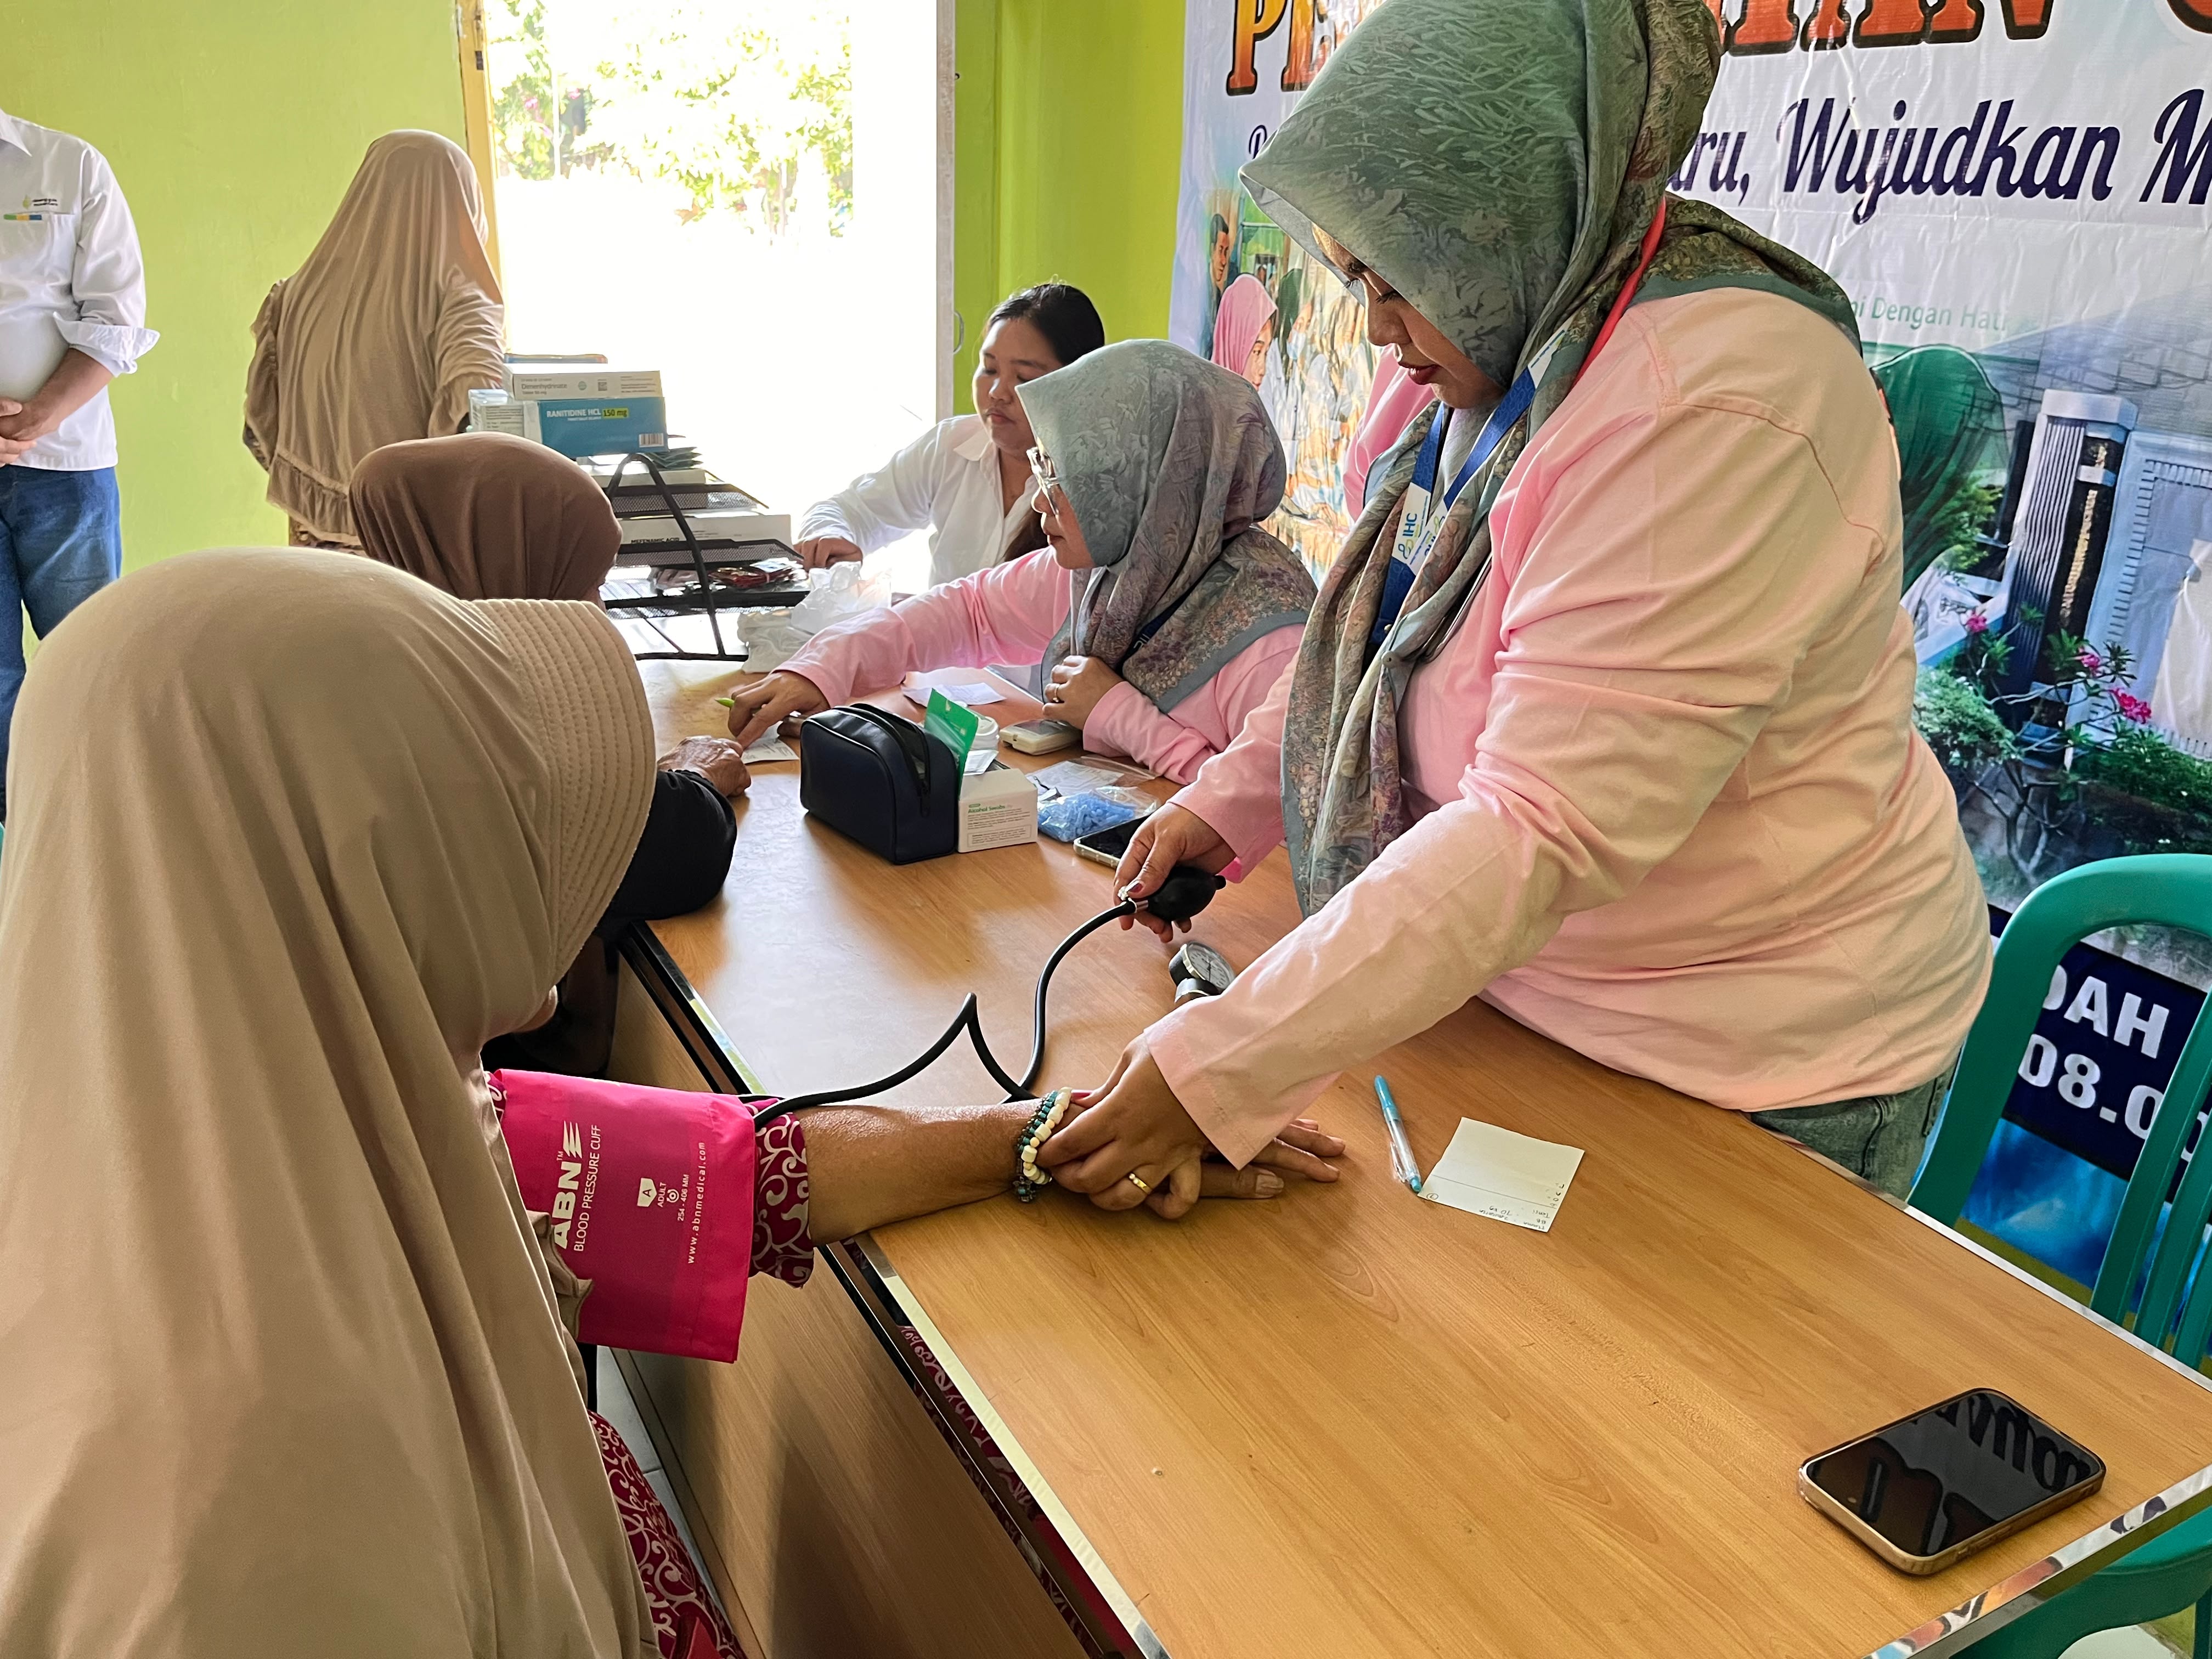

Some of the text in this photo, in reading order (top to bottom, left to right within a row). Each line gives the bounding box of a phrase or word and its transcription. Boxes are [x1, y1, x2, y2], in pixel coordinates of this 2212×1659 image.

[1666, 132, 1749, 206] ru,
[1778, 98, 2120, 224] Wujudkan
[1871, 297, 1952, 329] Dengan
[546, 409, 587, 417] RANITIDINE
[1402, 513, 1418, 537] IHC
[574, 1125, 601, 1251] BLOOD PRESSURE CUFF
[642, 1188, 652, 1198] A
[658, 1182, 667, 1207] ADULT
[682, 1175, 689, 1187] MM
[552, 1161, 582, 1249] ABN
[687, 1142, 706, 1264] www.abnmedical.com
